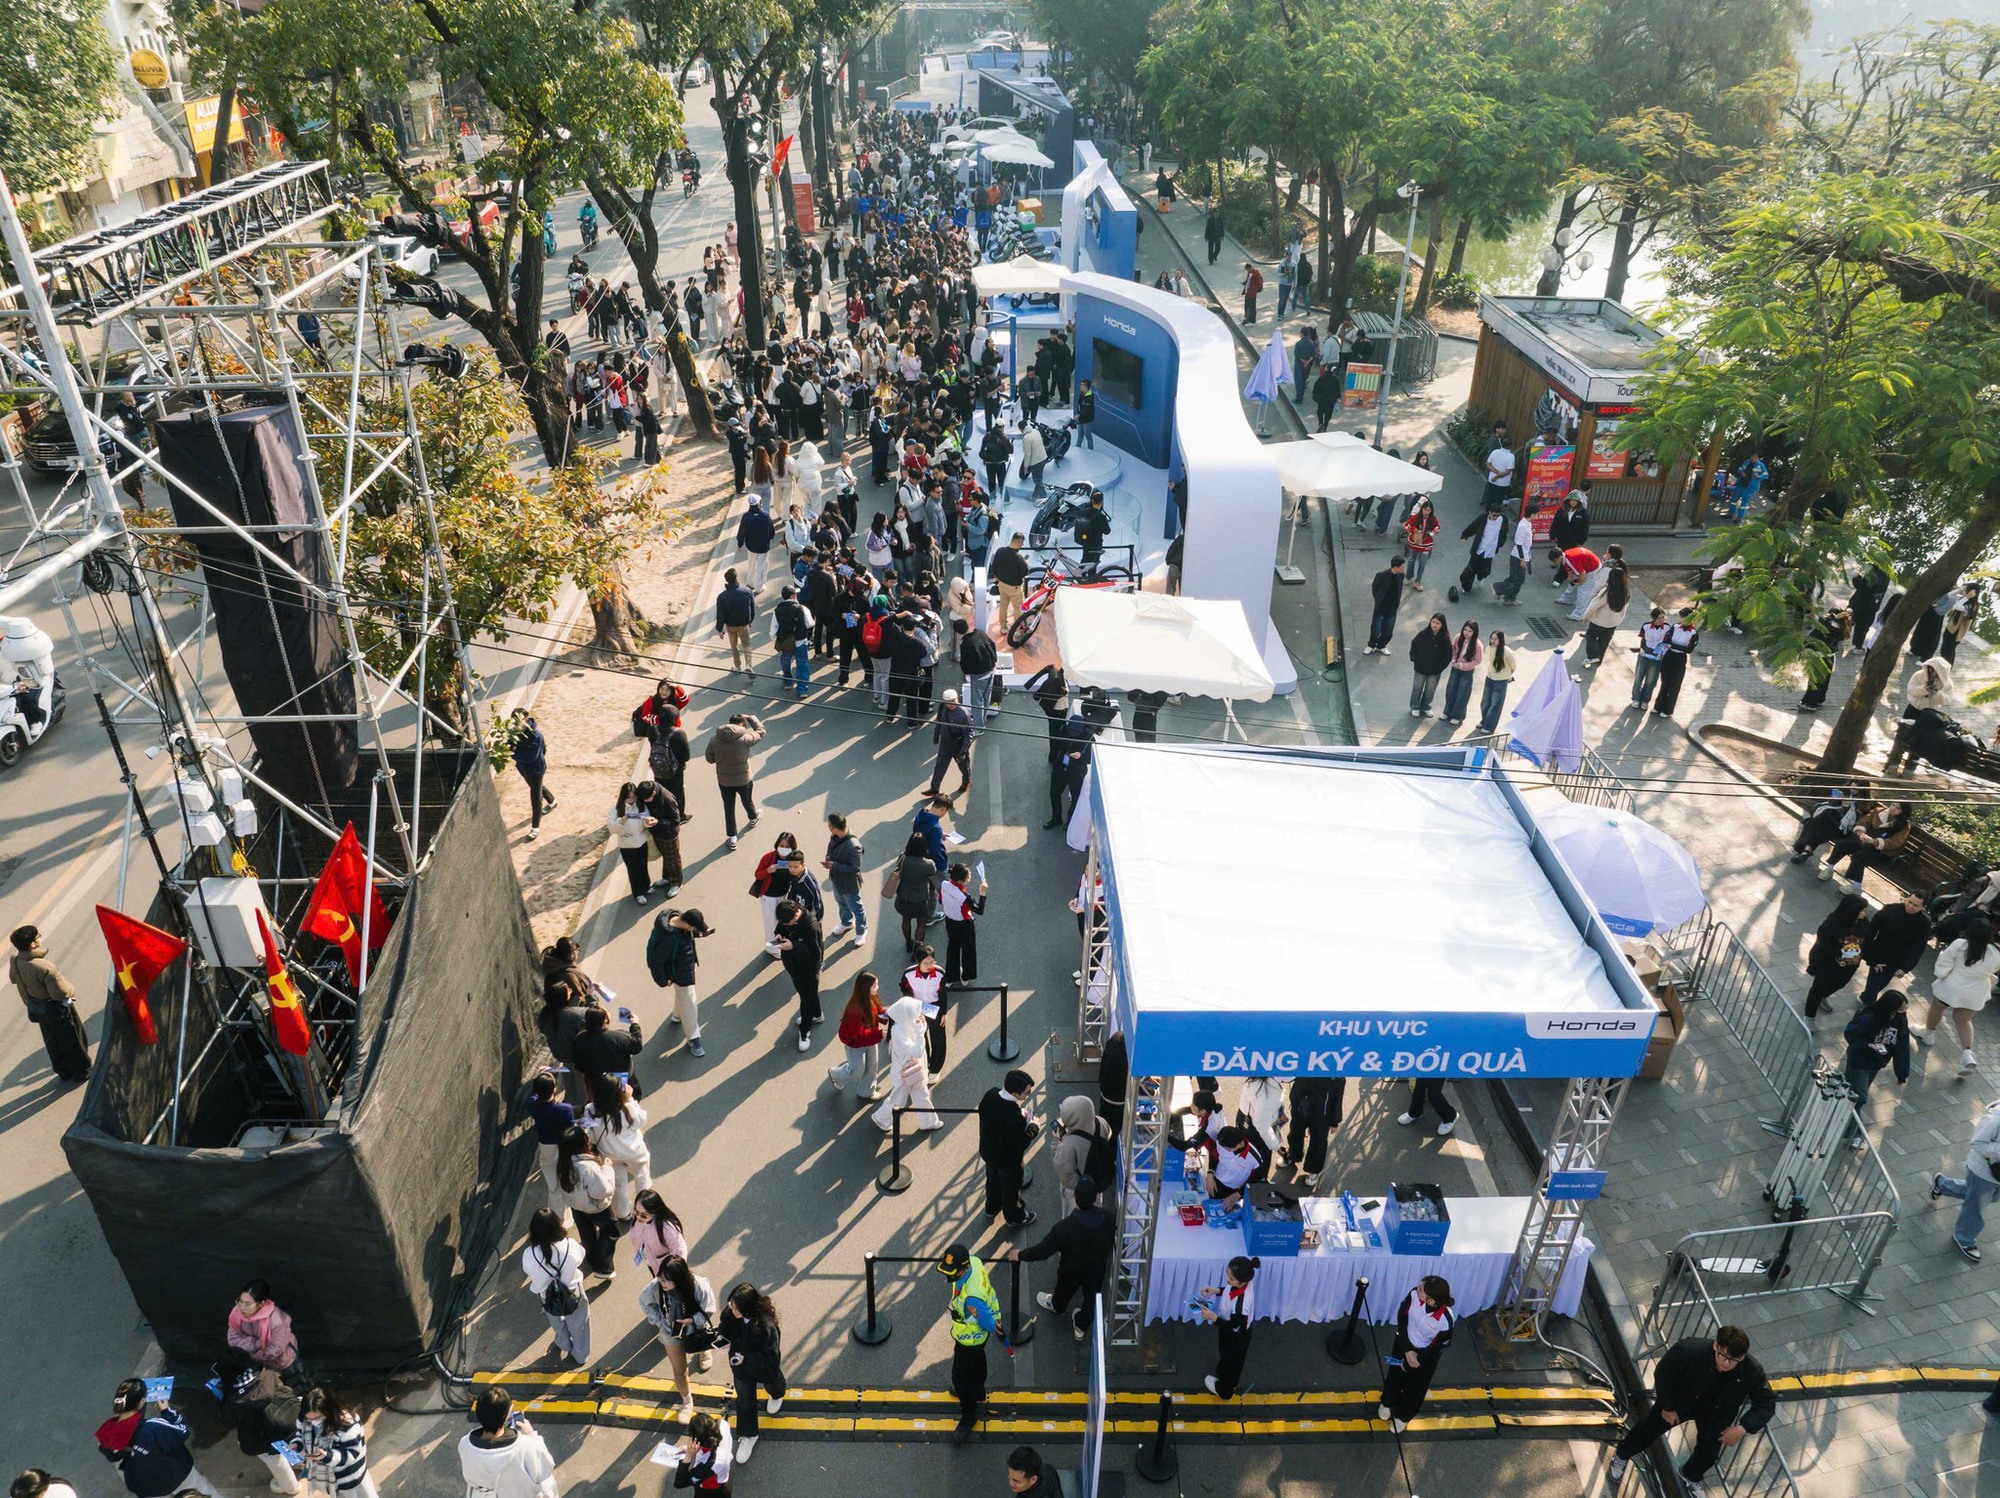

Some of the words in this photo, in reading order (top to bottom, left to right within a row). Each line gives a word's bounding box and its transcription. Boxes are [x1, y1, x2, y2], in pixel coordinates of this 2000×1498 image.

[133, 65, 164, 73] ALLUVIA
[1103, 314, 1137, 336] Honda
[1605, 922, 1636, 932] nda
[1318, 1020, 1371, 1036] KHU
[1376, 1019, 1428, 1039] VỰC
[1547, 1019, 1637, 1031] Honda
[1201, 1046, 1299, 1072] ĐĂNG
[1307, 1045, 1352, 1071] KÝ
[1360, 1051, 1383, 1072] &
[1390, 1045, 1449, 1072] ĐỔI
[1457, 1047, 1527, 1074] QUÀ
[1405, 1231, 1441, 1239] Honda
